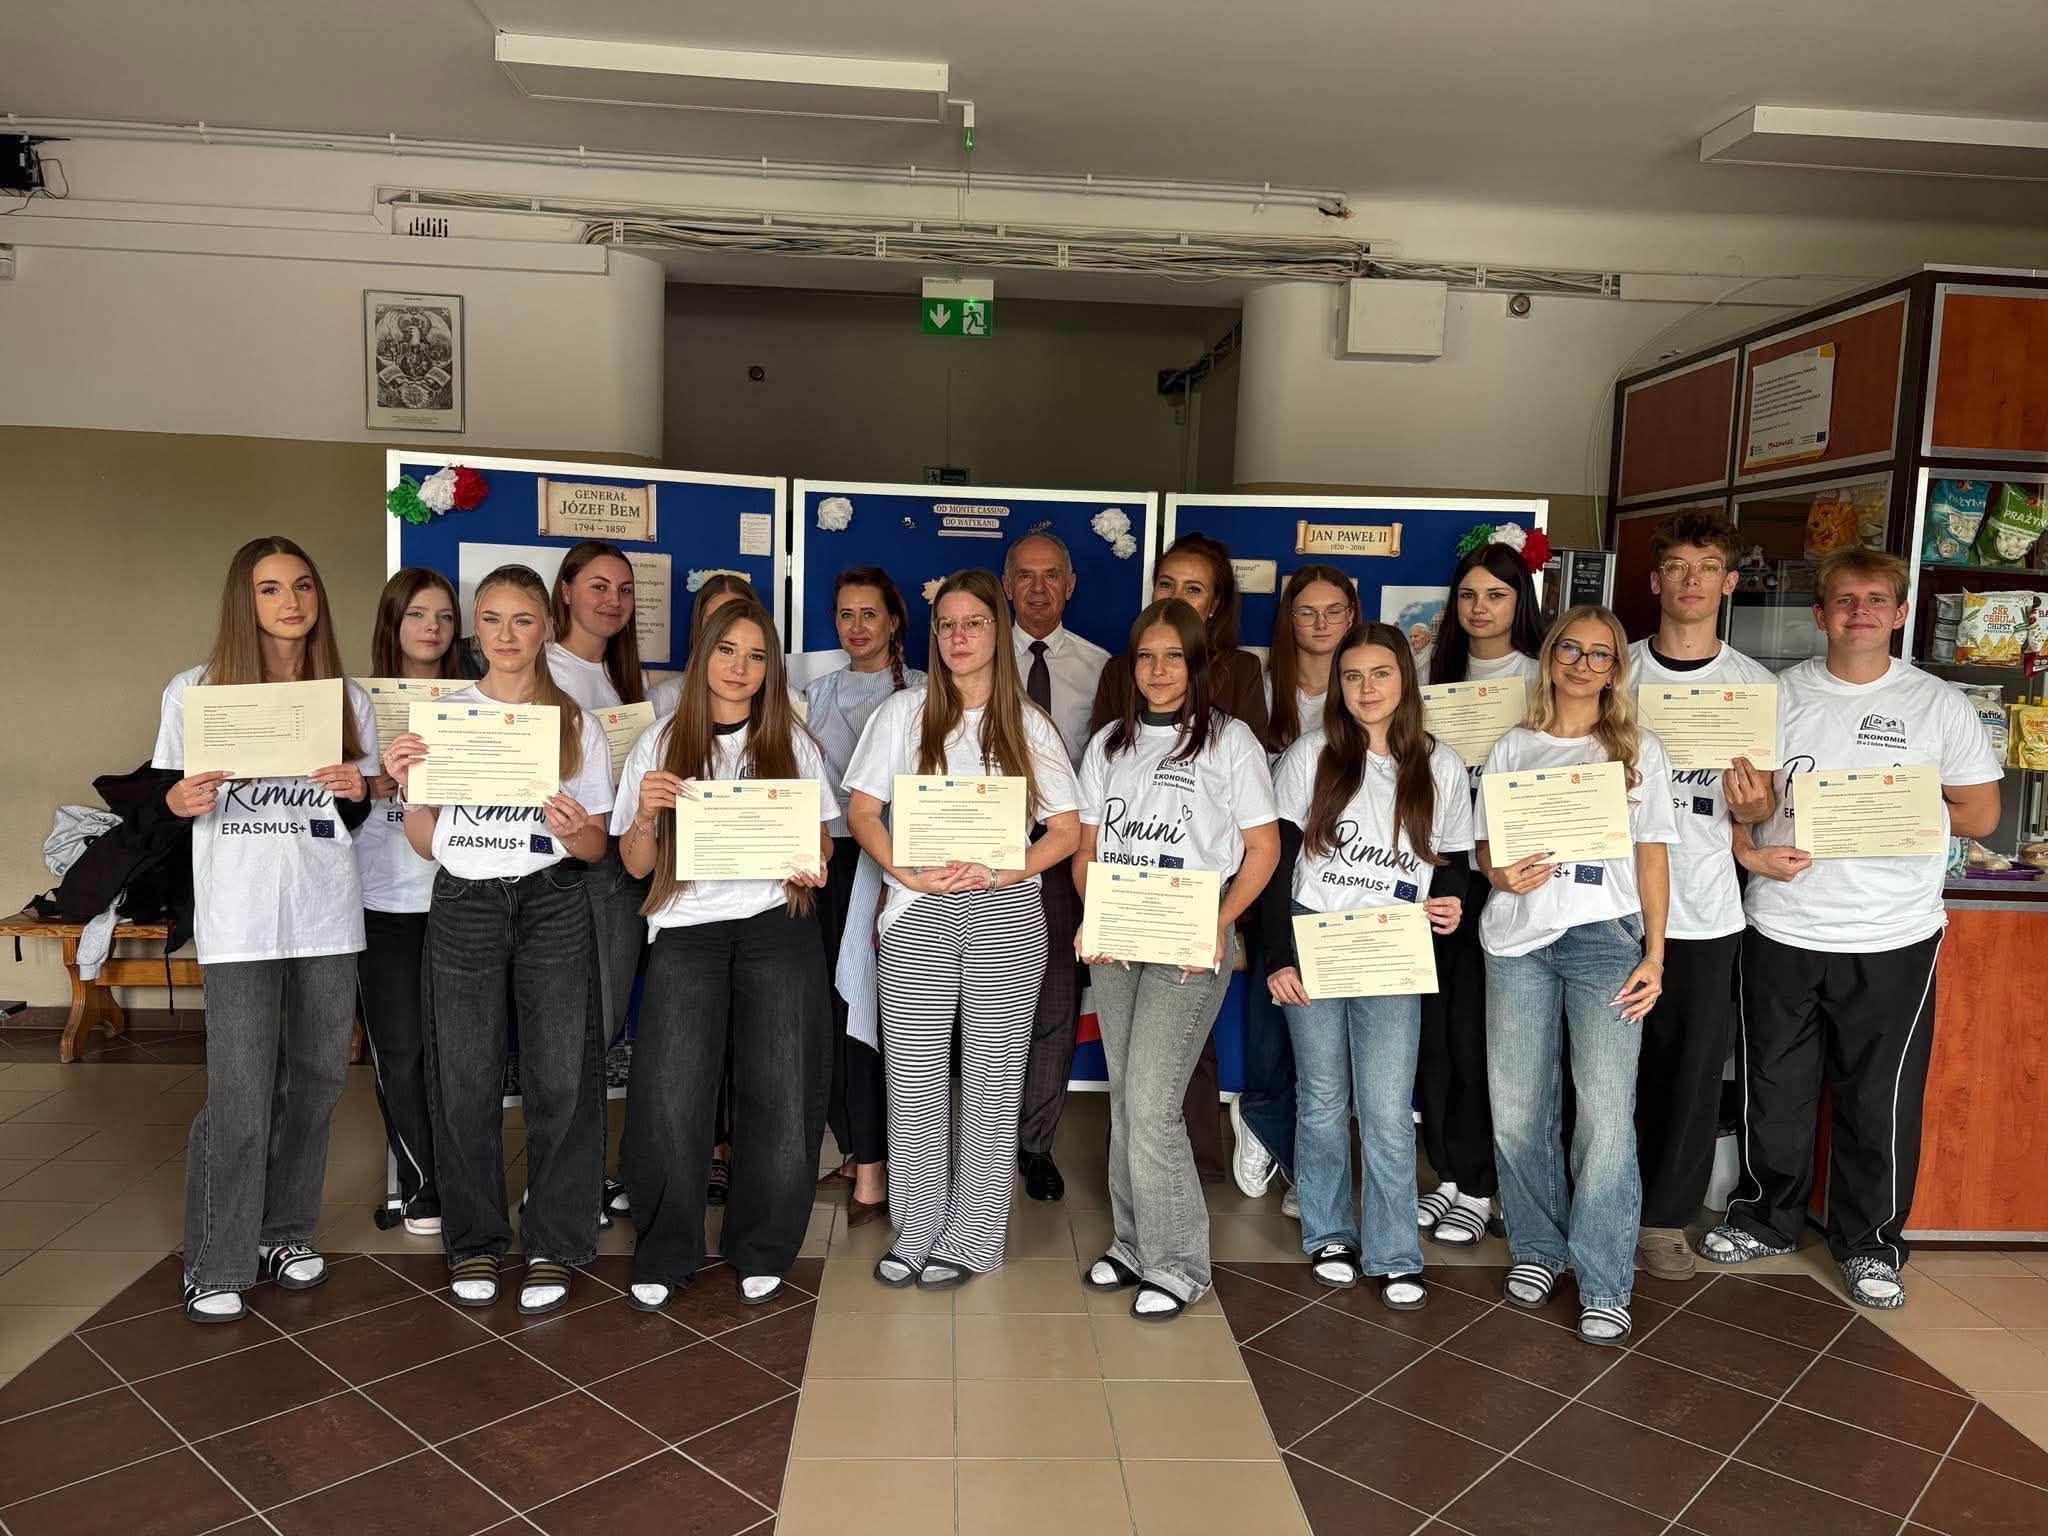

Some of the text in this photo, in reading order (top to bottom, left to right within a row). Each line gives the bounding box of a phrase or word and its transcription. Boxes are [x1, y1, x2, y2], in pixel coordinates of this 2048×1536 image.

[575, 489, 627, 501] GENERAŁ
[560, 500, 640, 517] JÓZEF BEM
[949, 505, 976, 513] MONTE
[574, 523, 594, 532] 1794
[606, 525, 626, 533] 1850
[957, 519, 996, 527] WATYKANU
[1310, 530, 1387, 542] JAN PAWEŁ II
[1858, 733, 1906, 744] EKONOMIK
[1154, 773, 1195, 786] EKONOMIK
[221, 822, 306, 835] ERASMUS+
[448, 835, 525, 849] ERASMUS+
[1322, 872, 1390, 891] ERASMUS+
